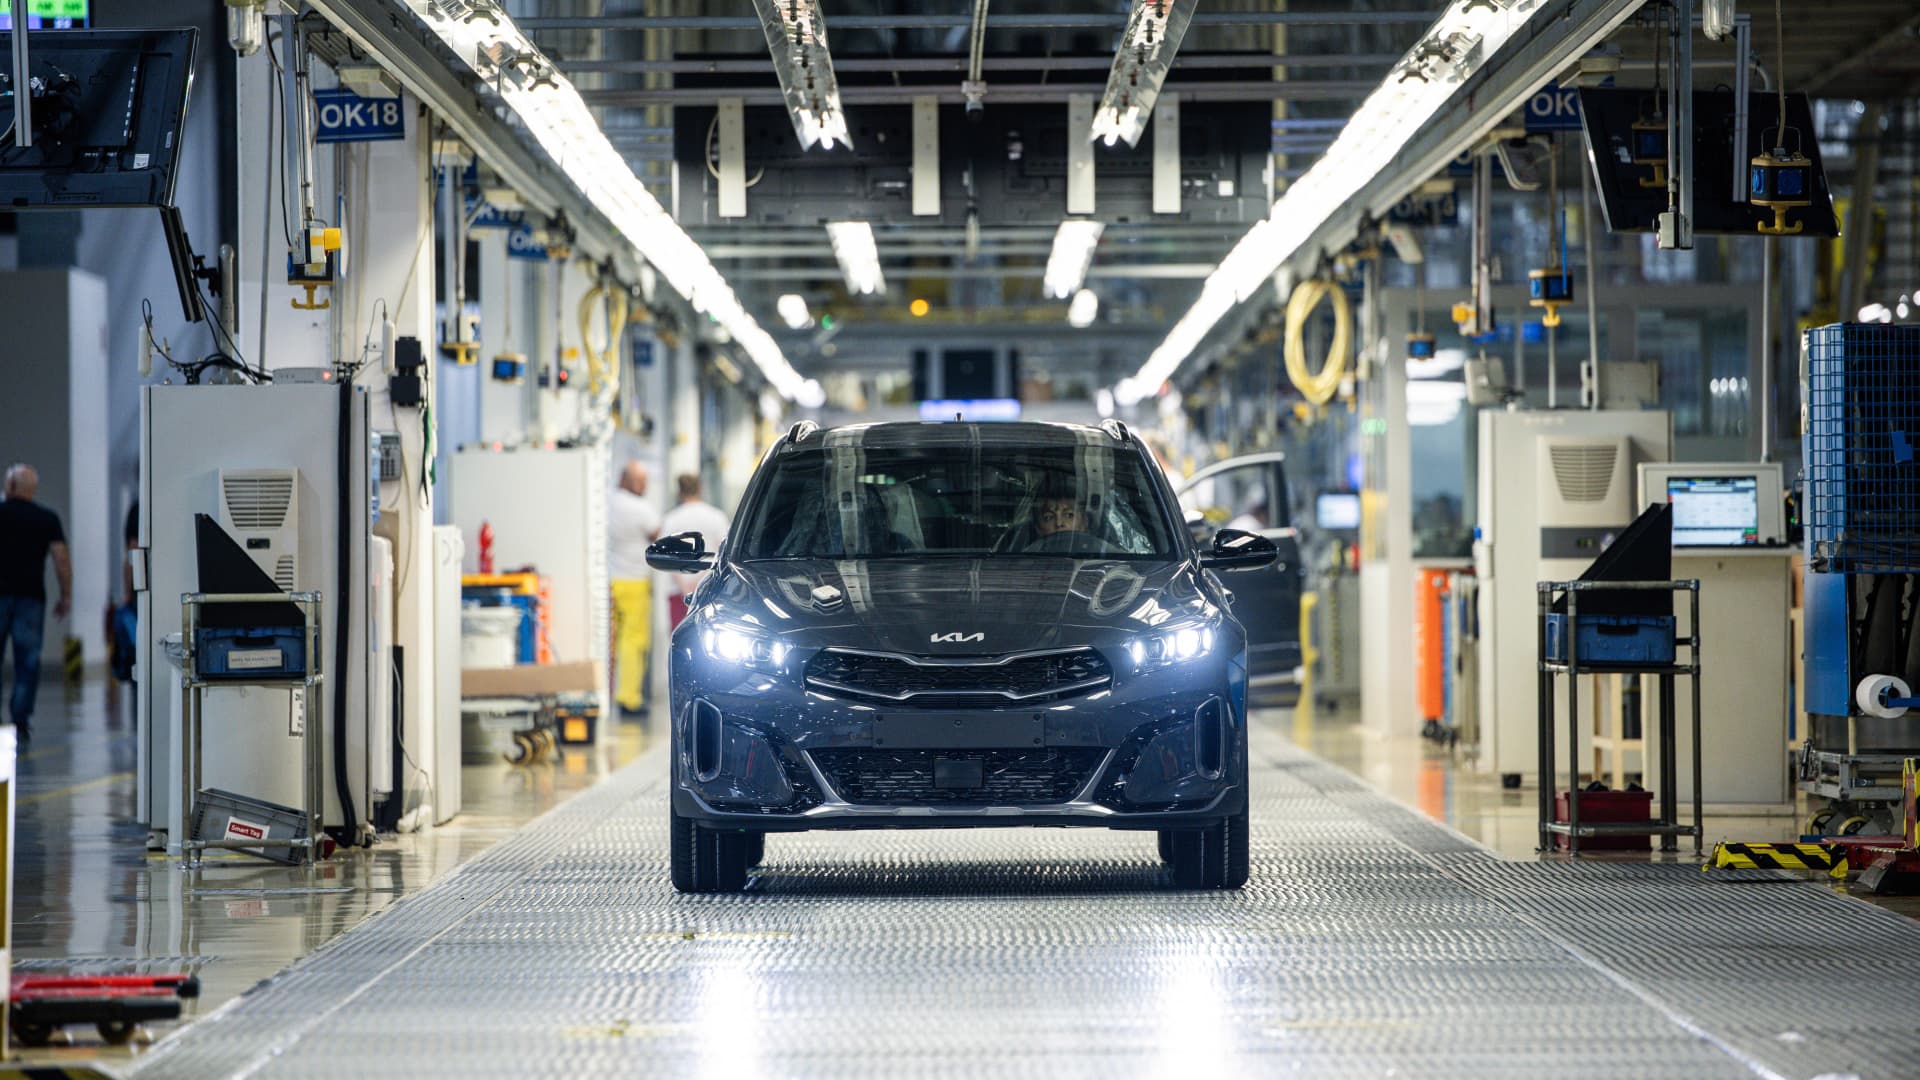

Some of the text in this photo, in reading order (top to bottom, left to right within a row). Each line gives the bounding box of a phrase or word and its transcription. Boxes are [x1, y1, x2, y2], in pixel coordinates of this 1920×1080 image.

[1531, 92, 1576, 116] OK
[320, 102, 399, 128] OK18
[930, 632, 985, 643] KIA
[231, 824, 248, 834] Smart
[250, 829, 261, 839] Tag
